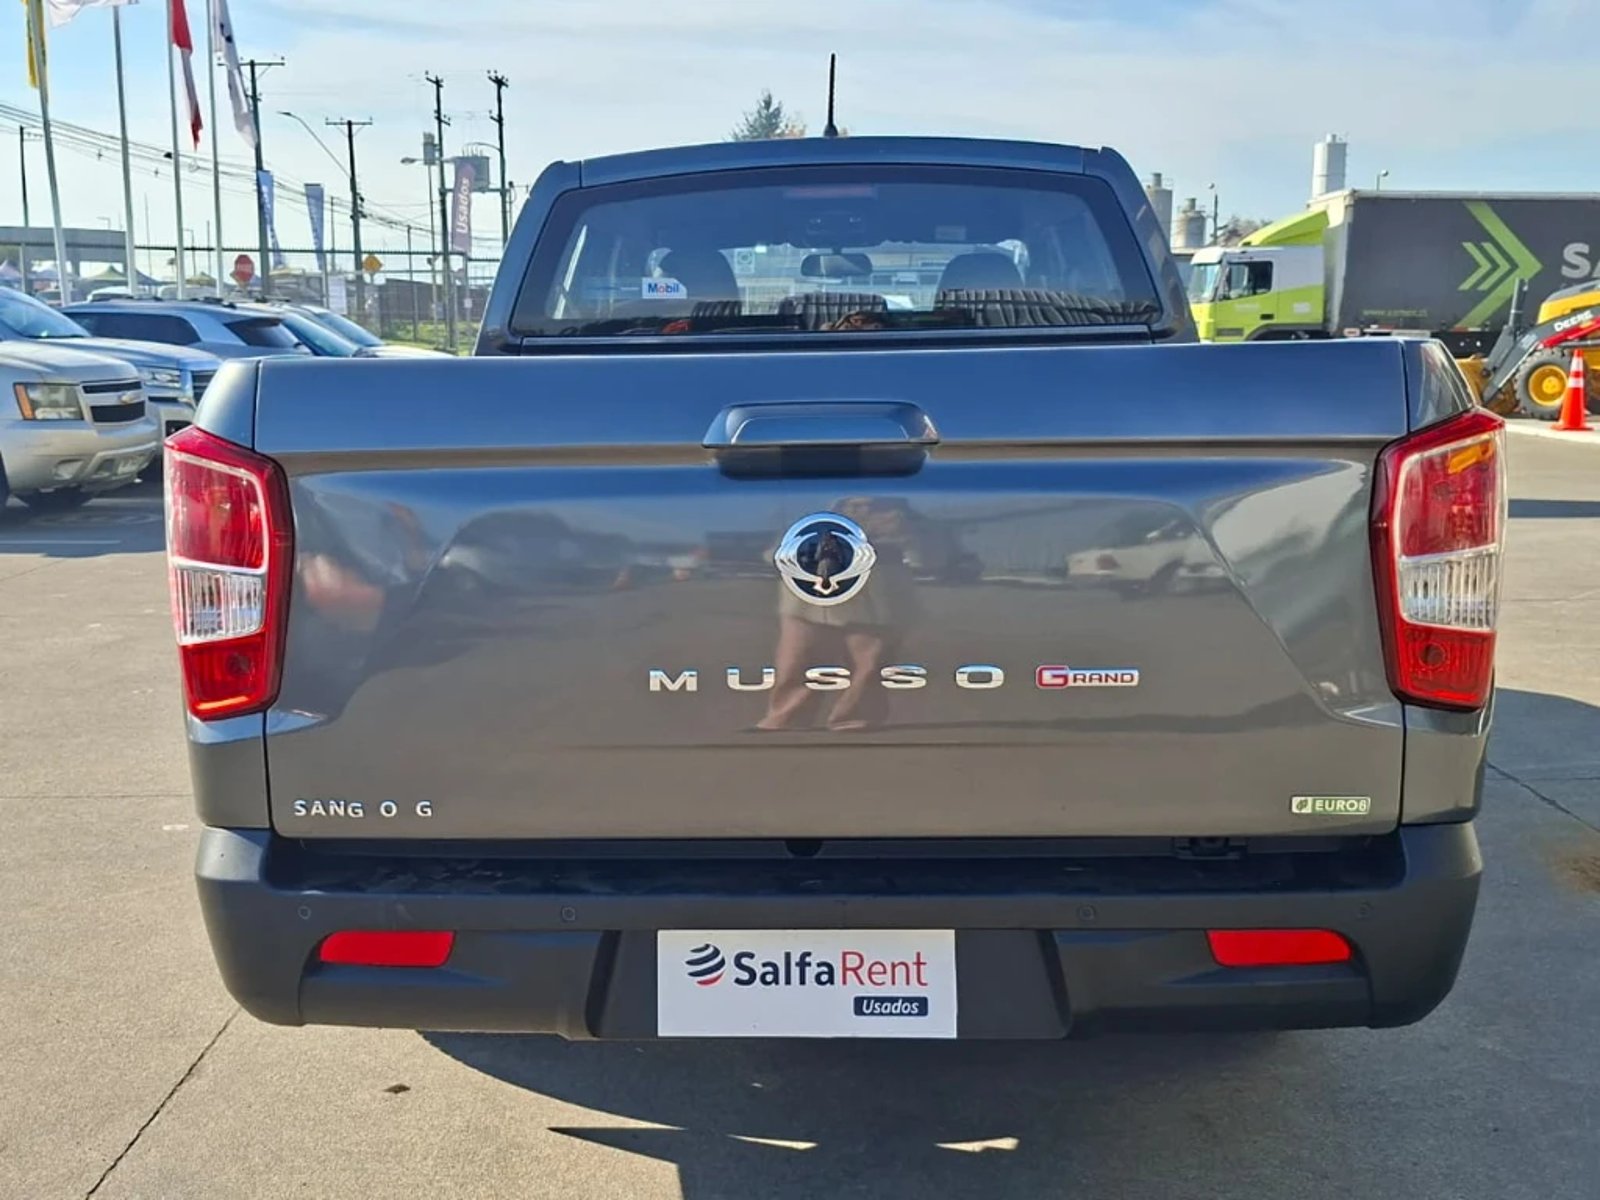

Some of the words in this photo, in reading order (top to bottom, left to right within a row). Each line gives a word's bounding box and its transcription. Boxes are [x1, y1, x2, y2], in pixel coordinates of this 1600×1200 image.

[456, 177, 470, 234] Usados
[1561, 242, 1600, 279] S
[647, 282, 680, 294] Mobil
[649, 665, 1005, 692] MUSSO
[293, 799, 364, 818] SANG
[861, 998, 920, 1015] Usados
